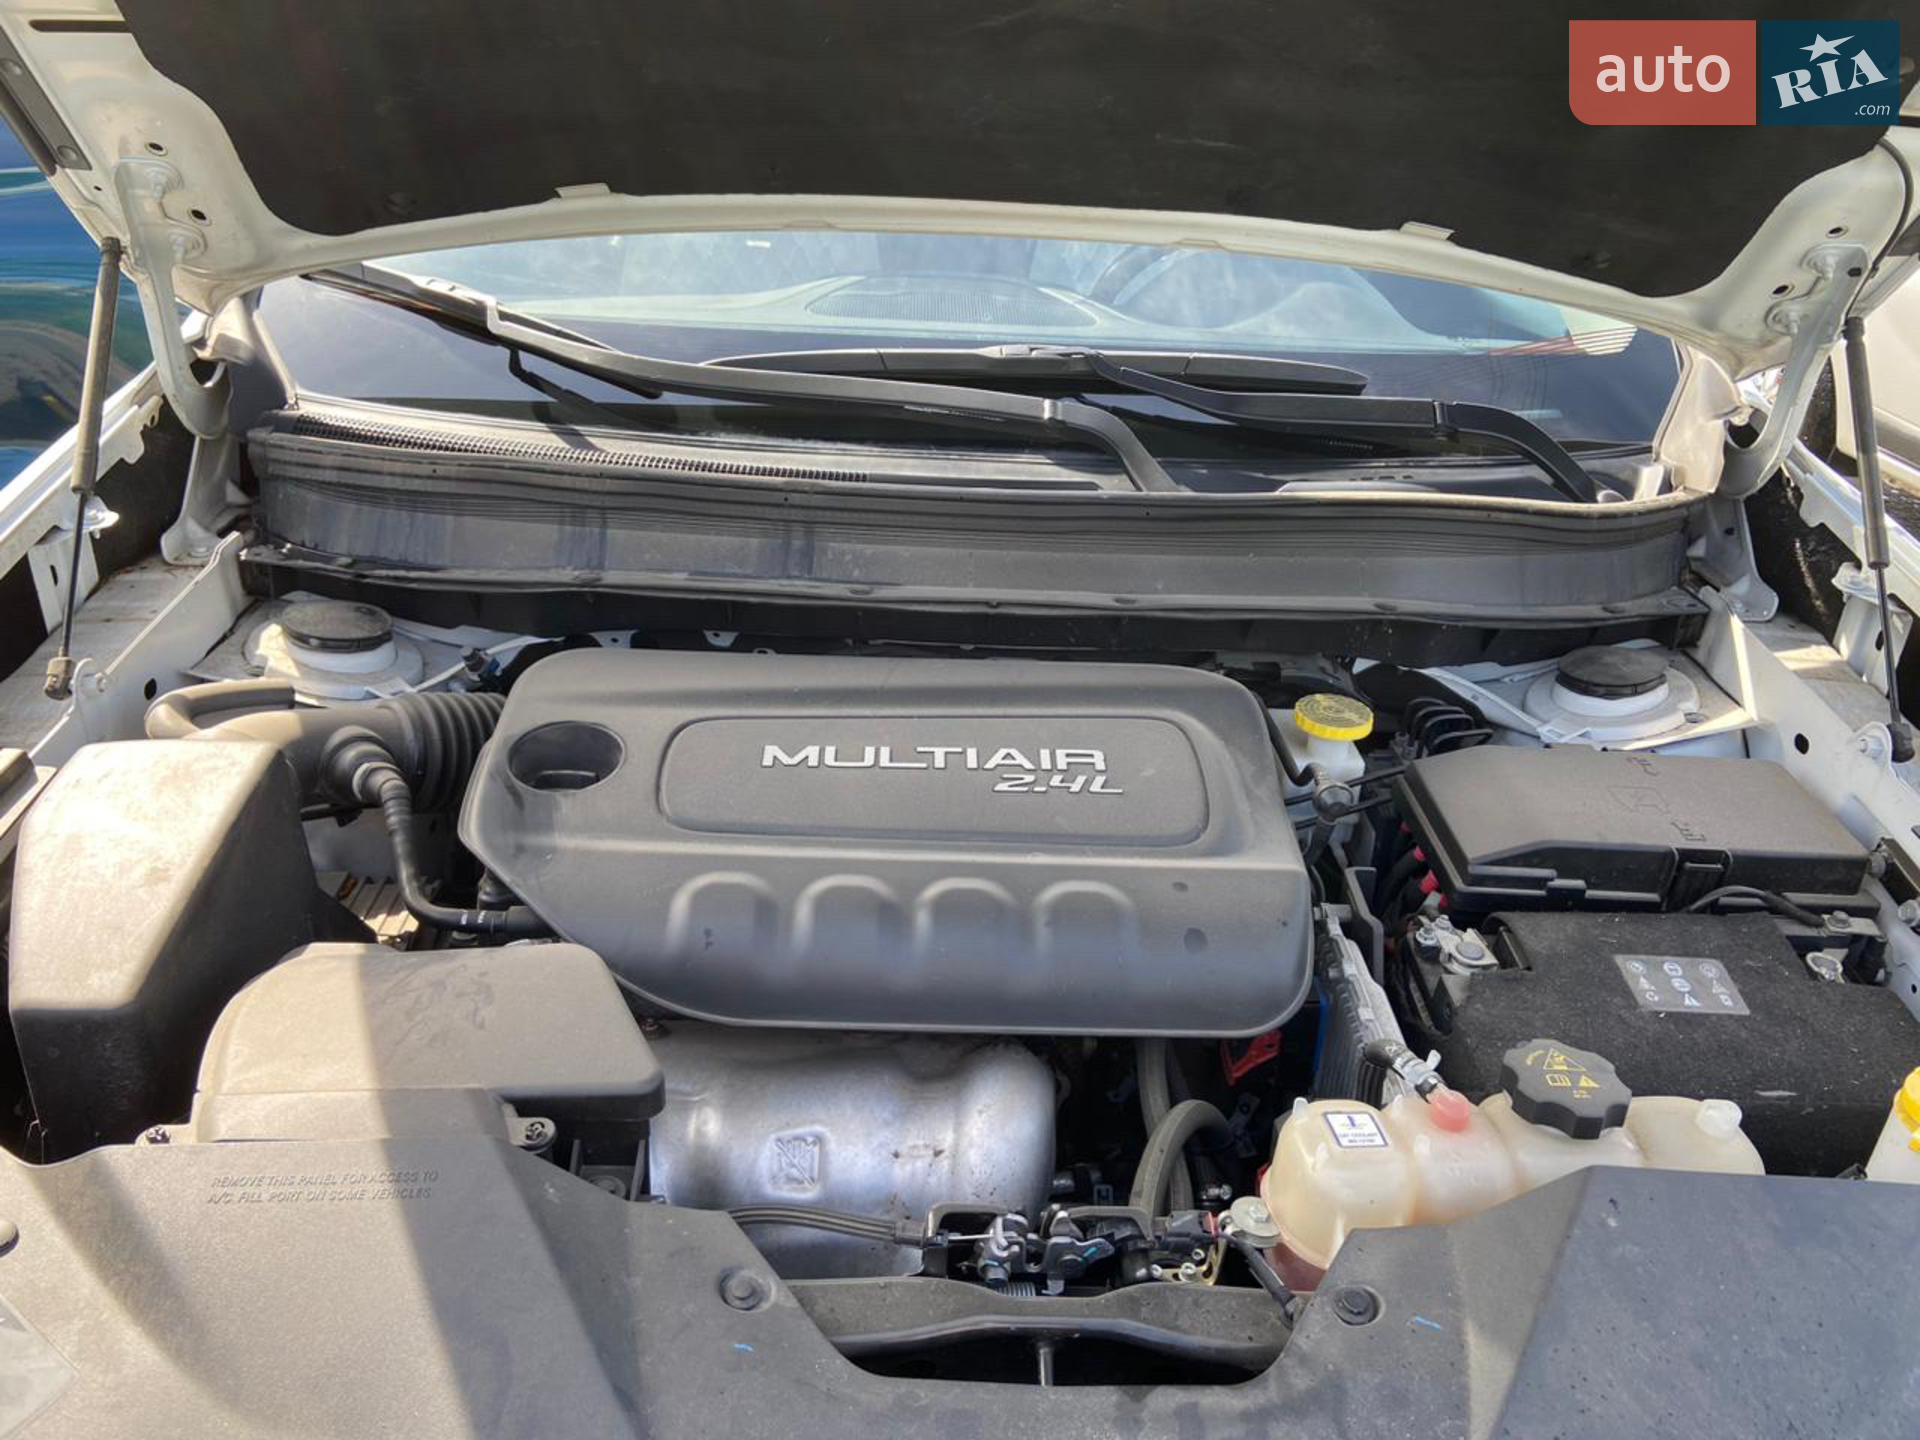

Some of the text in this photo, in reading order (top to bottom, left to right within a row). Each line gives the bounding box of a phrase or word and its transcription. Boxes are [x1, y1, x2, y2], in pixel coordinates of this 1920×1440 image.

[761, 745, 1107, 771] MULTIAIR
[992, 773, 1124, 794] 2.4L
[211, 1170, 440, 1189] REMOVE THIS PANEL FOR ACCESS TO
[206, 1186, 431, 1205] A/C FILL PORT ON SOME VEHICLES
